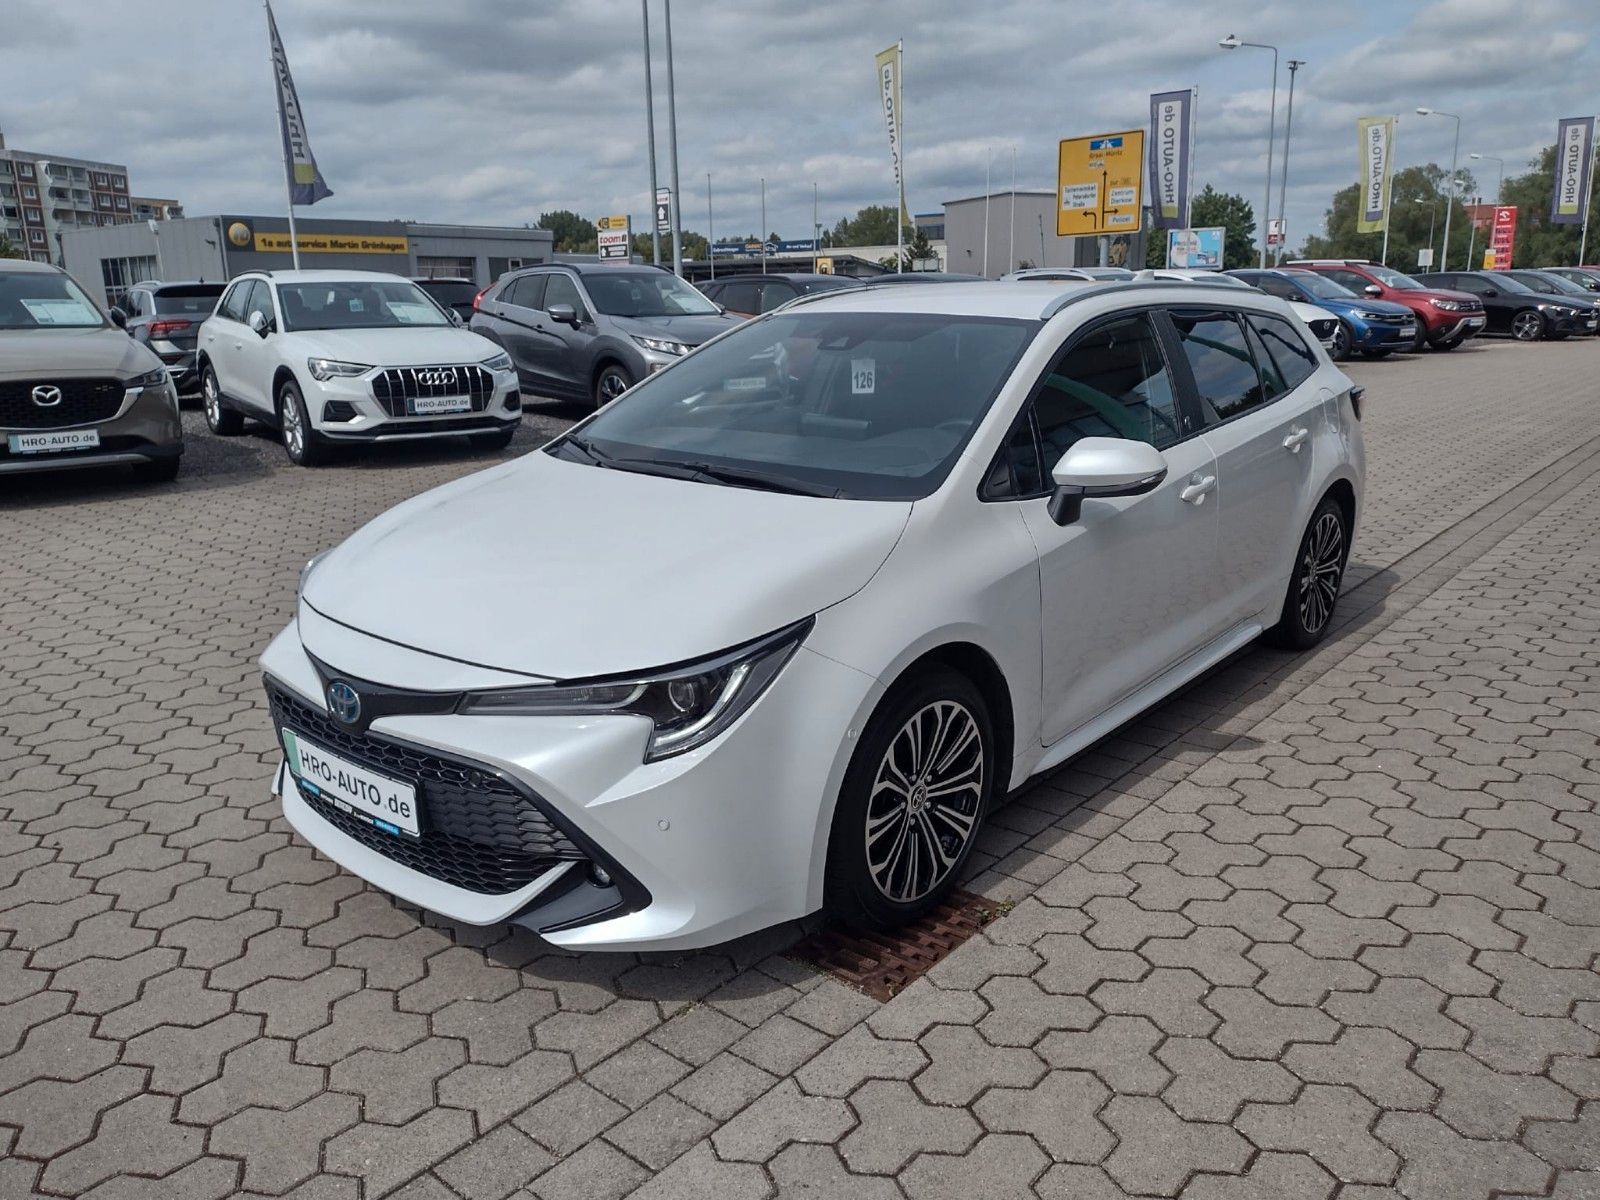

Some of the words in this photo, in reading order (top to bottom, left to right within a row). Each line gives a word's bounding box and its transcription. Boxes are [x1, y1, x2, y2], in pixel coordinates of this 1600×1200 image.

[276, 239, 327, 249] autservice
[330, 239, 359, 249] Martin
[853, 371, 873, 389] 126
[300, 749, 411, 818] HRO-AUTO.de
